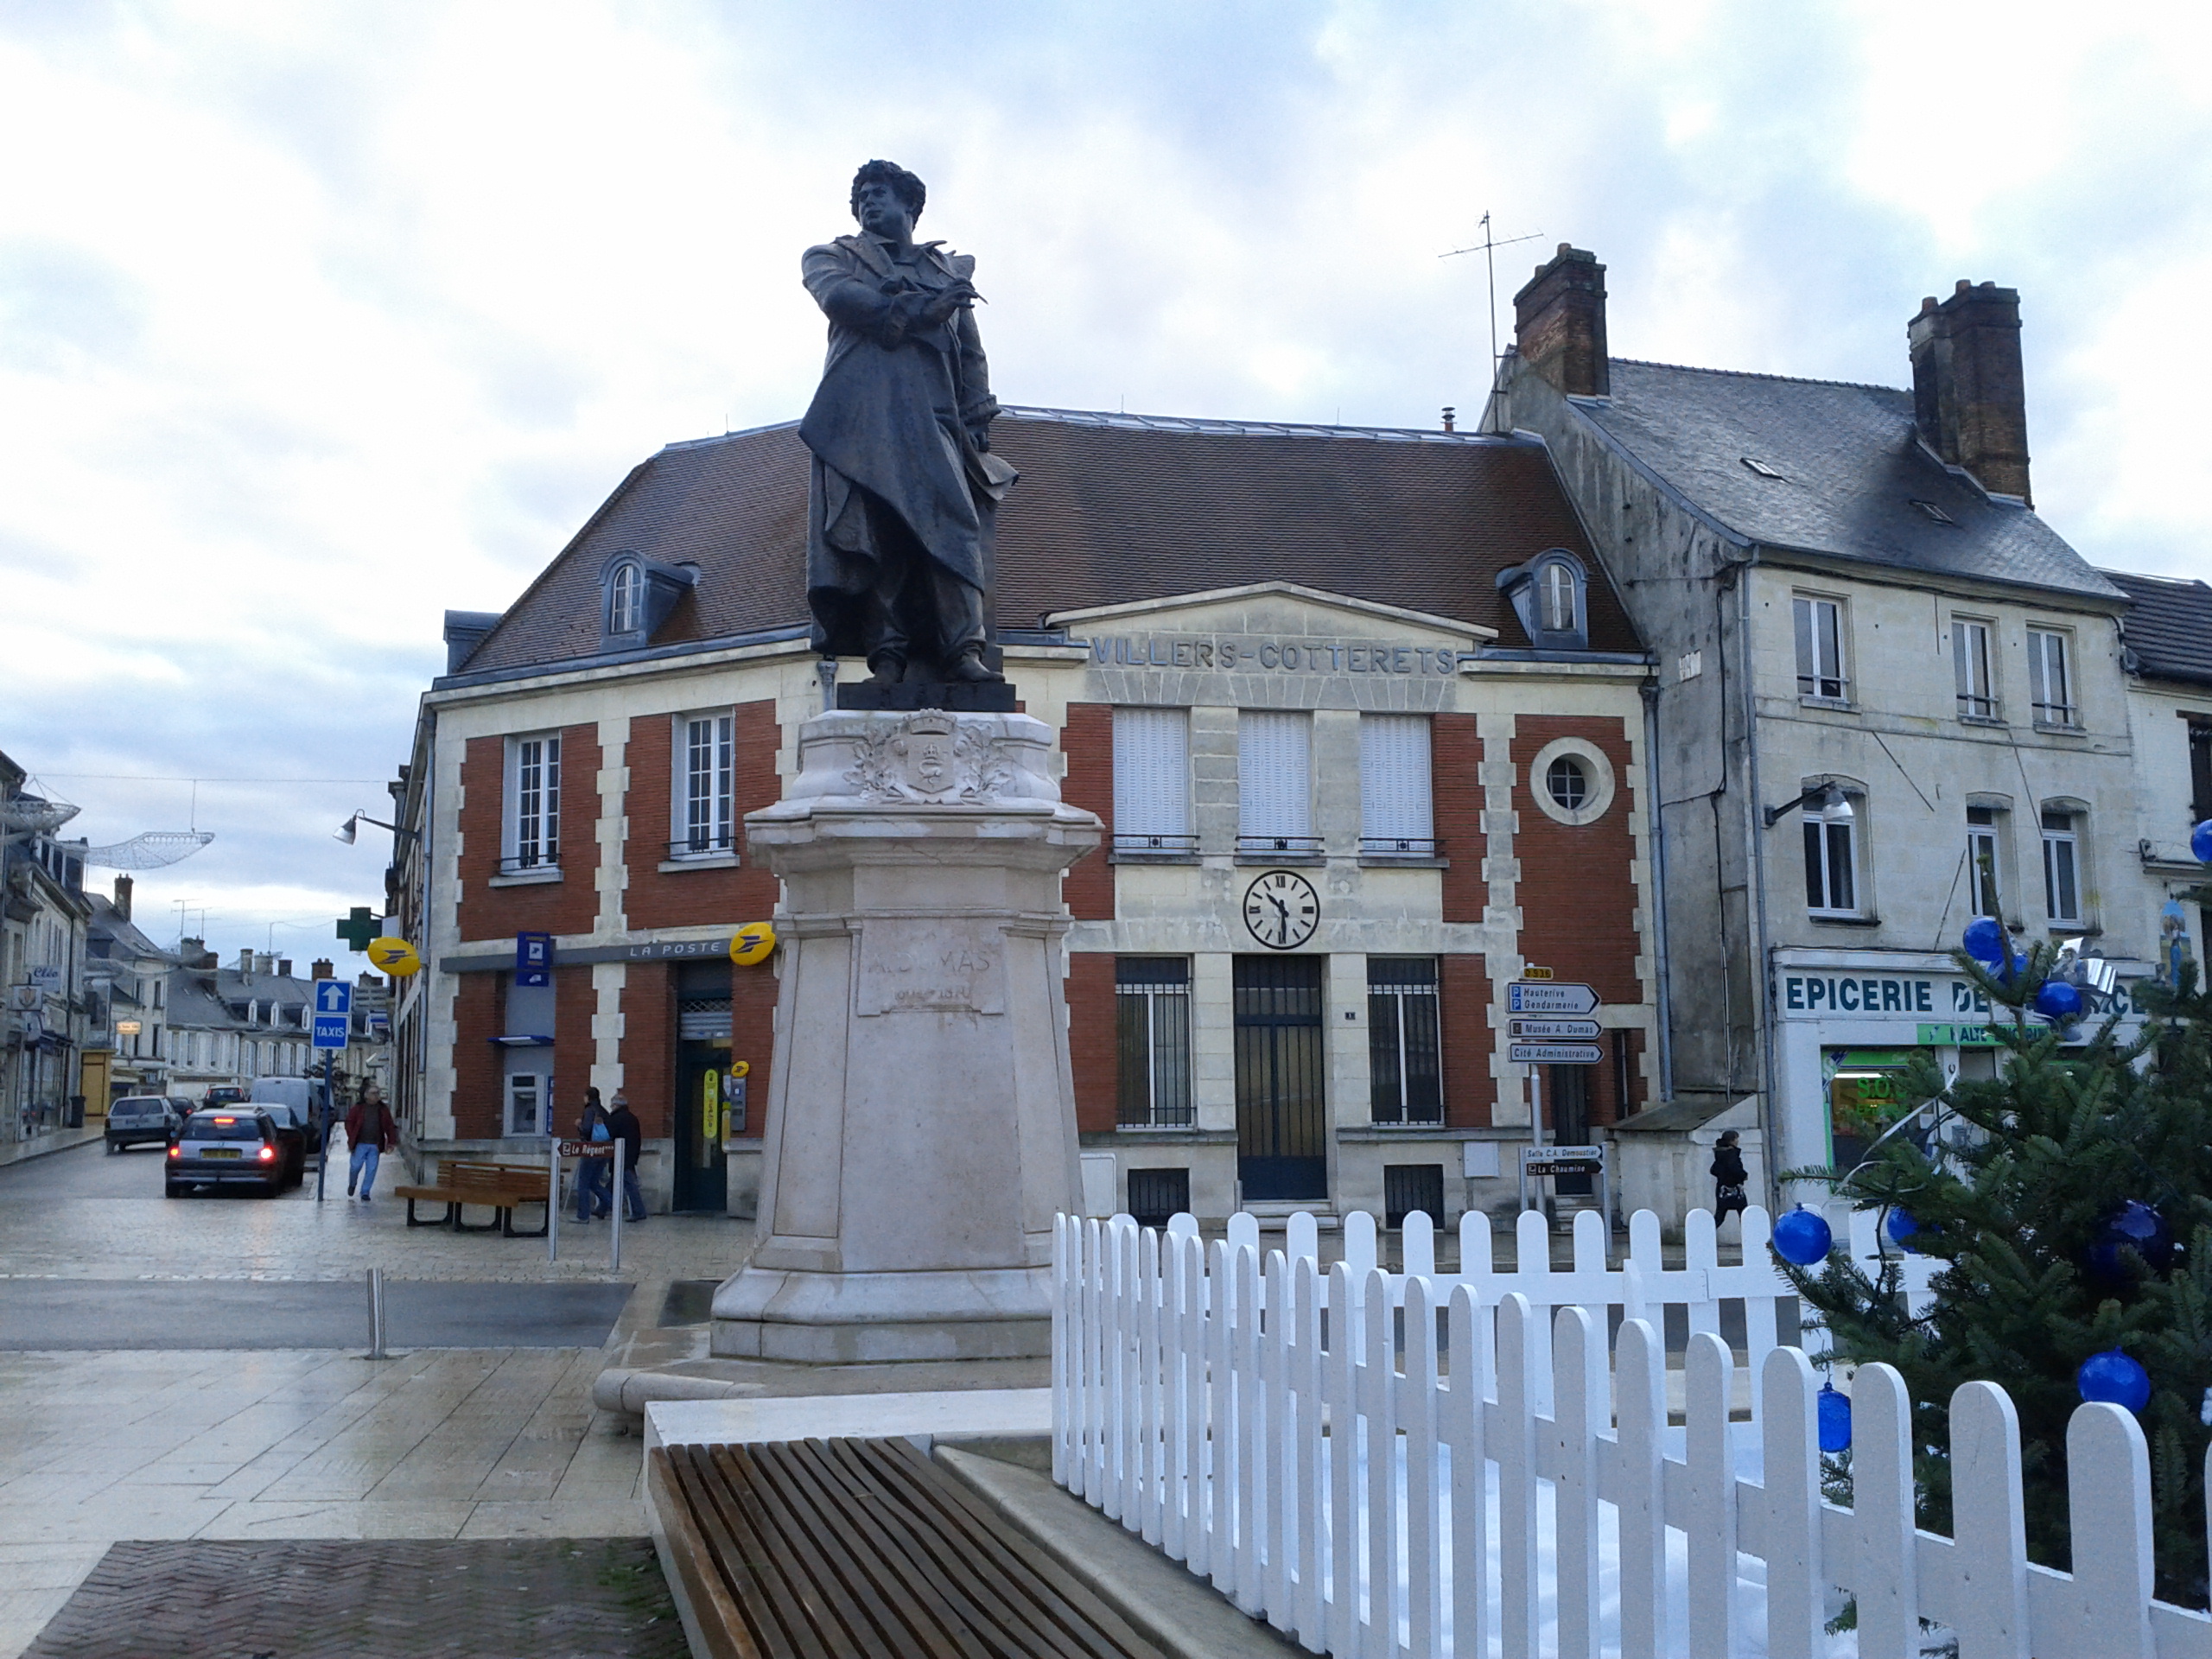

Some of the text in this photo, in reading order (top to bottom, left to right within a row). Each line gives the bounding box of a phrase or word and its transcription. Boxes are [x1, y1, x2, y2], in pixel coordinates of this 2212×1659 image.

[1093, 637, 1455, 674] VILLERS-COTTERETS
[630, 942, 721, 957] LA POSTE
[898, 950, 990, 975] DMAS
[1523, 988, 1565, 997] Hauterive
[1786, 977, 1932, 1011] EPICERIE
[1524, 1000, 1579, 1009] Gendarmerie
[316, 1026, 345, 1038] TAXIS
[1526, 1024, 1551, 1033] Musée
[1567, 1025, 1593, 1033] Dumas
[1514, 1048, 1595, 1058] Cité Administrative
[572, 1144, 580, 1154] Le
